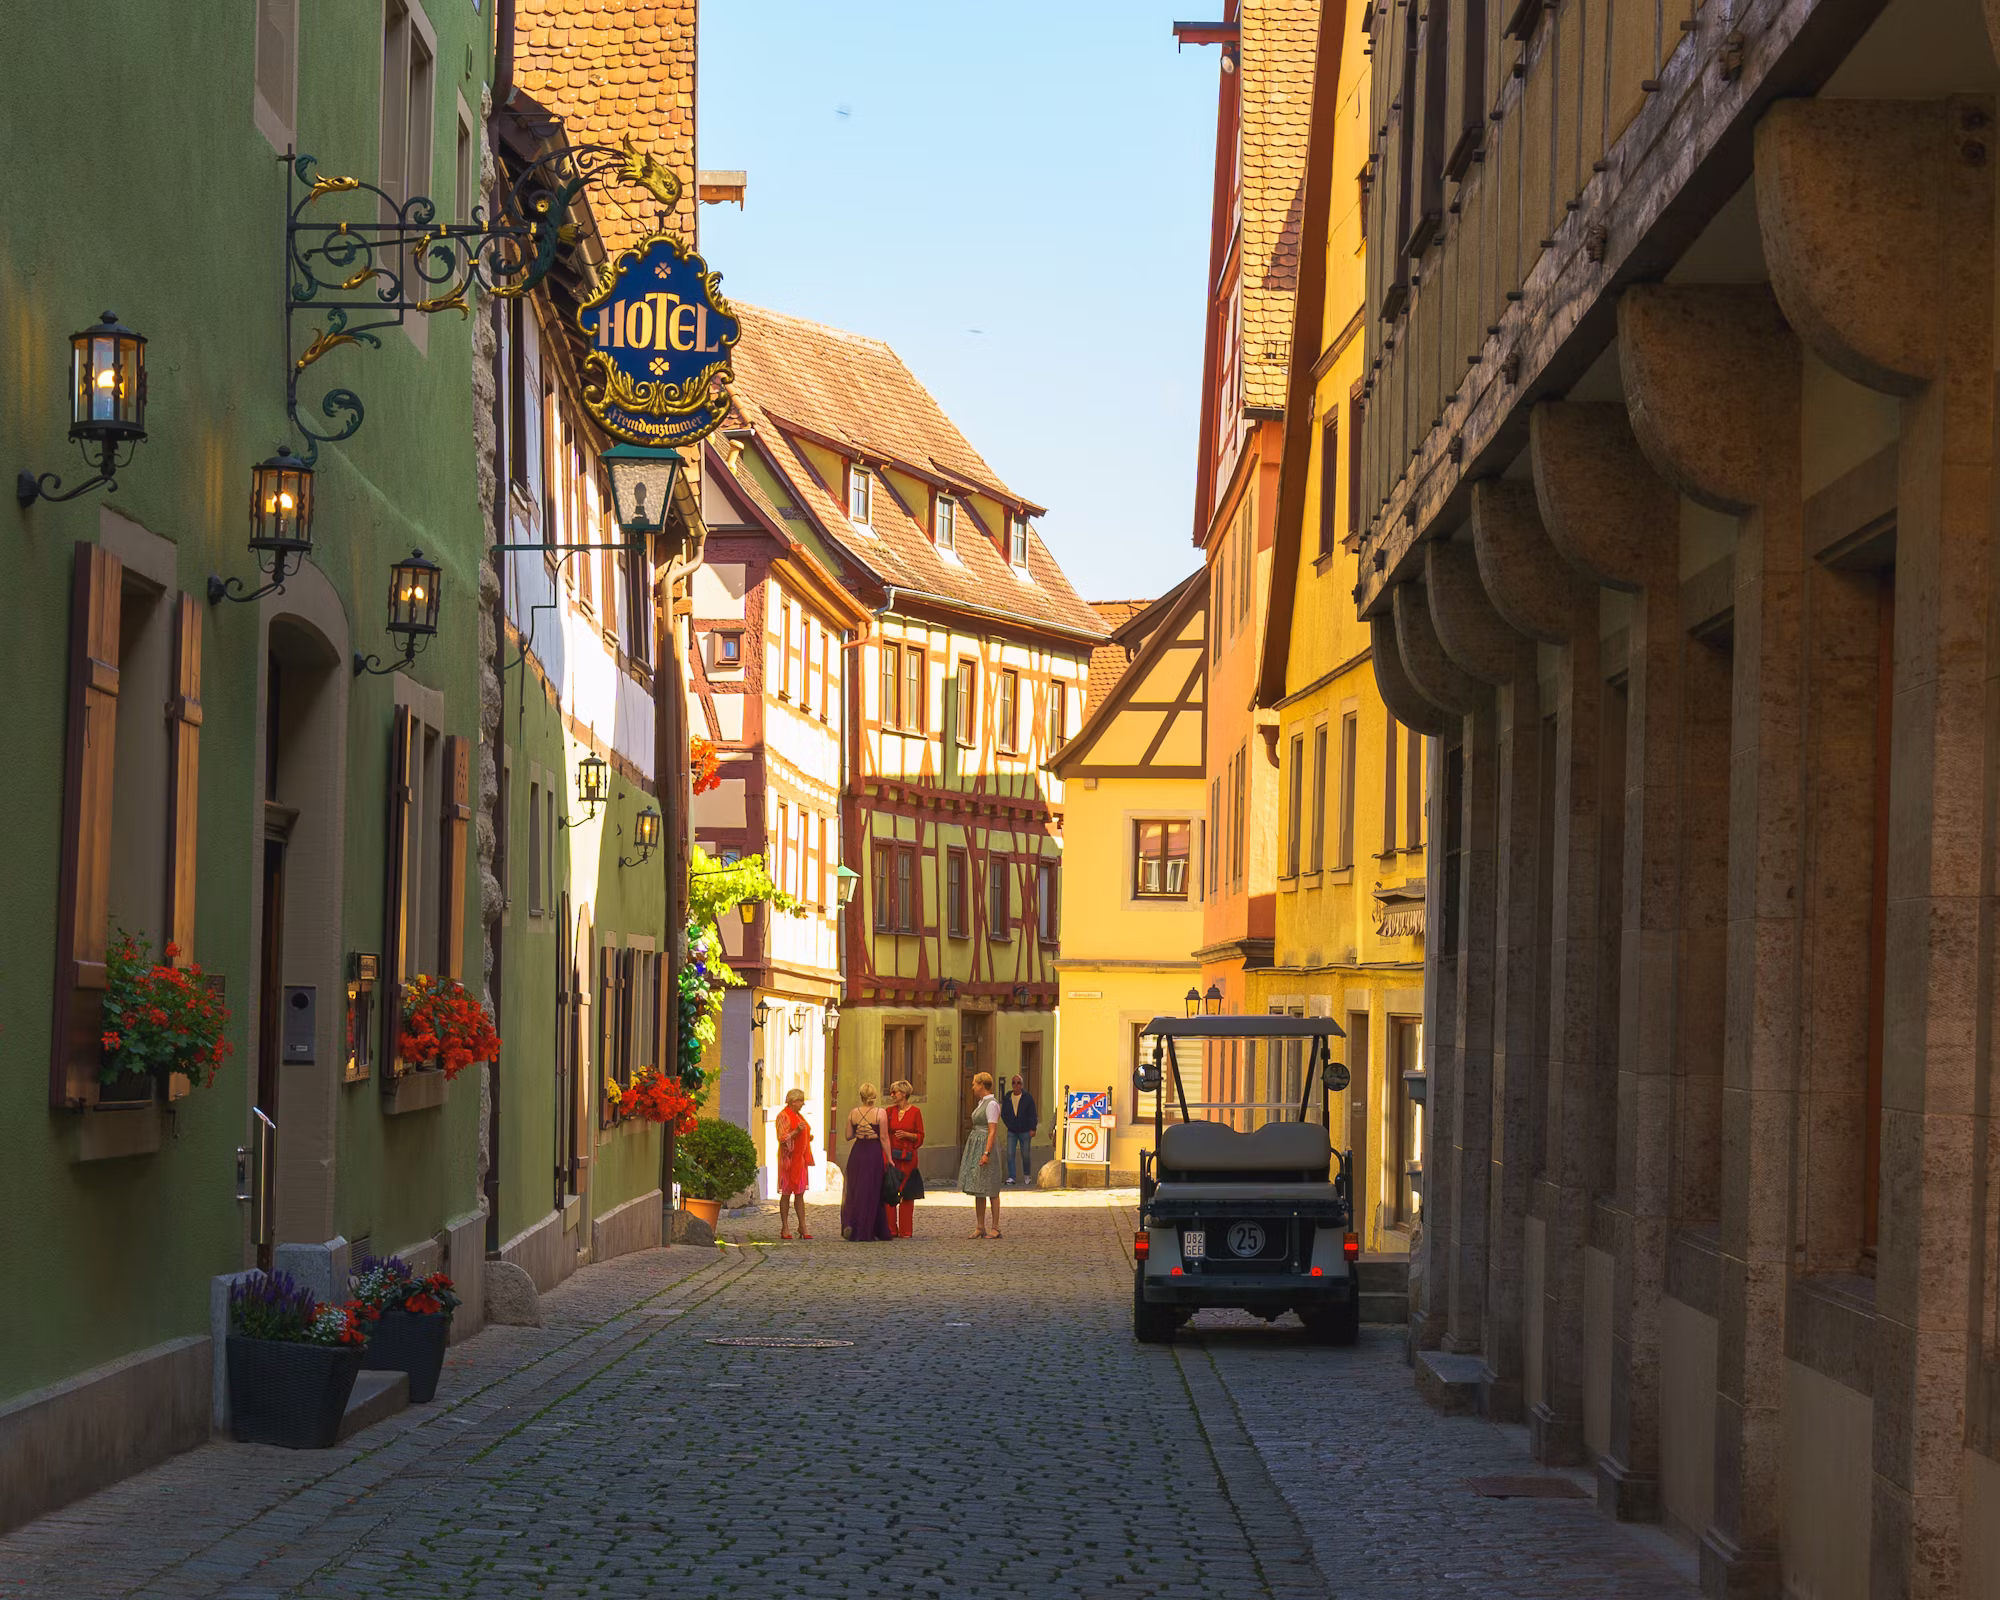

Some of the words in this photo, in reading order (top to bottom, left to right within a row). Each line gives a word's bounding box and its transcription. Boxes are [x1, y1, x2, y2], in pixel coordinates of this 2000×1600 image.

[598, 292, 719, 353] HOTEL
[607, 408, 703, 437] Fremdenzimmer
[1080, 1132, 1094, 1144] 20
[1186, 1234, 1203, 1244] 082
[1236, 1227, 1258, 1251] 25
[1185, 1245, 1204, 1256] GEE
